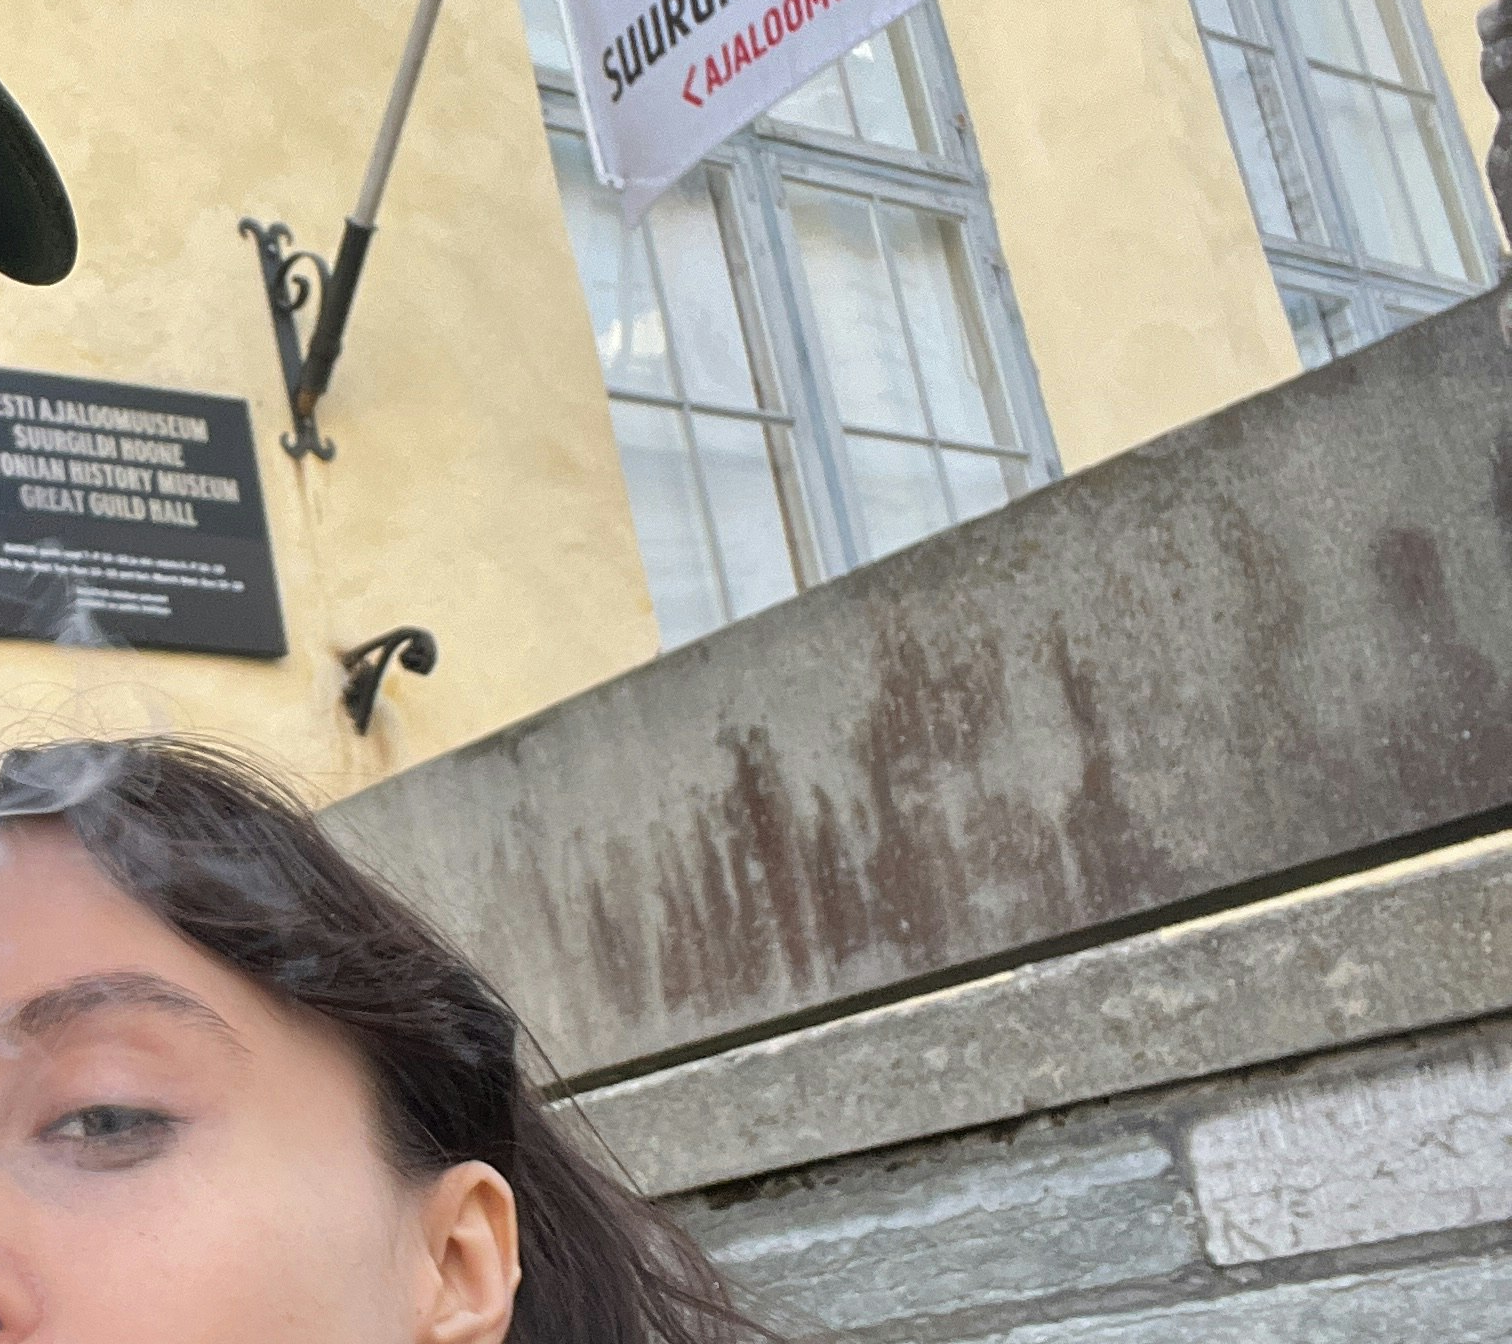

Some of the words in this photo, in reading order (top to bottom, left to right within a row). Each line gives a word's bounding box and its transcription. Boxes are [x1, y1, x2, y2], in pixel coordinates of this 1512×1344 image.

[39, 396, 209, 444] AJALOOMUUSEUM
[12, 423, 117, 460] SUURGILDI
[120, 436, 185, 468] HOONE
[69, 458, 154, 494] HISTORY
[156, 469, 240, 504] MUSEUM
[19, 483, 85, 516] GREAT
[89, 492, 146, 522] GUILD
[149, 498, 199, 528] HALL
